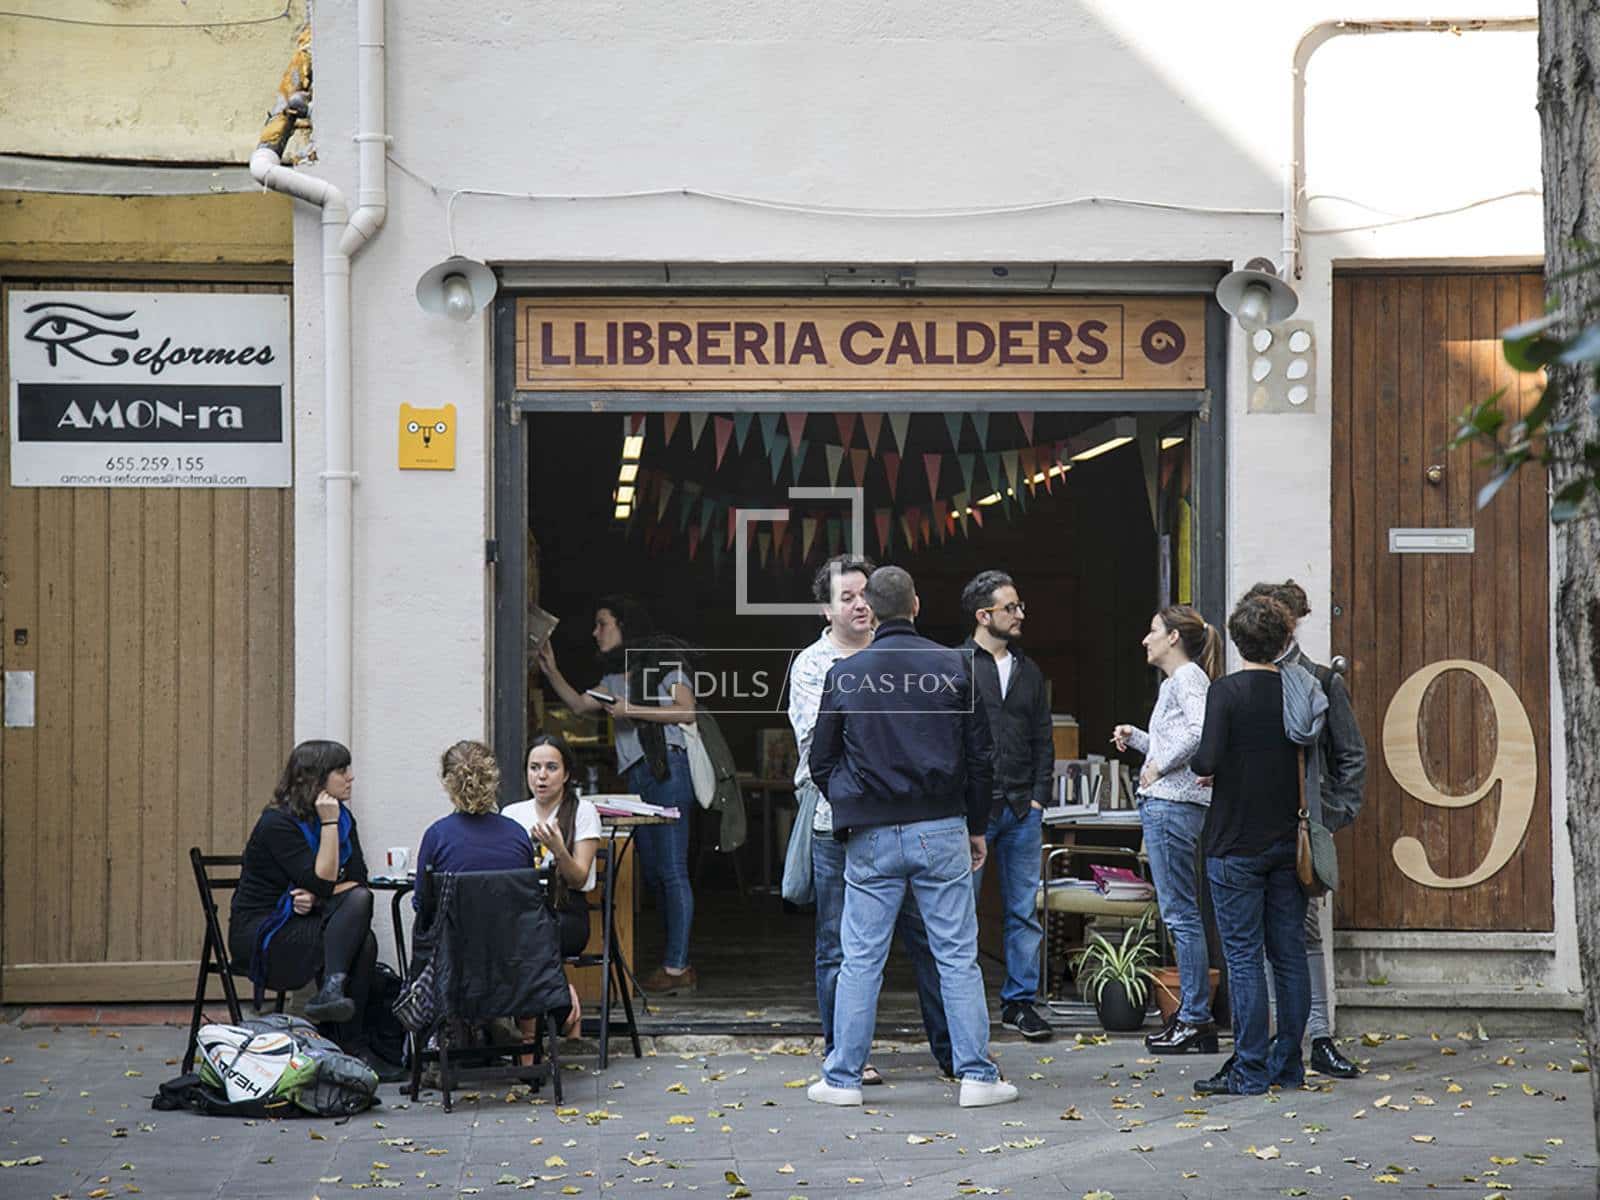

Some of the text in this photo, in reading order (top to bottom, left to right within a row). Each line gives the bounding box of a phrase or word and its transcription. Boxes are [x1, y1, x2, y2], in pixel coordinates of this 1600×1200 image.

[541, 320, 1108, 366] LLIBRERIA CALDERS
[57, 400, 243, 429] AMON-ra
[105, 456, 205, 471] 655.259.155
[1383, 659, 1536, 888] 9
